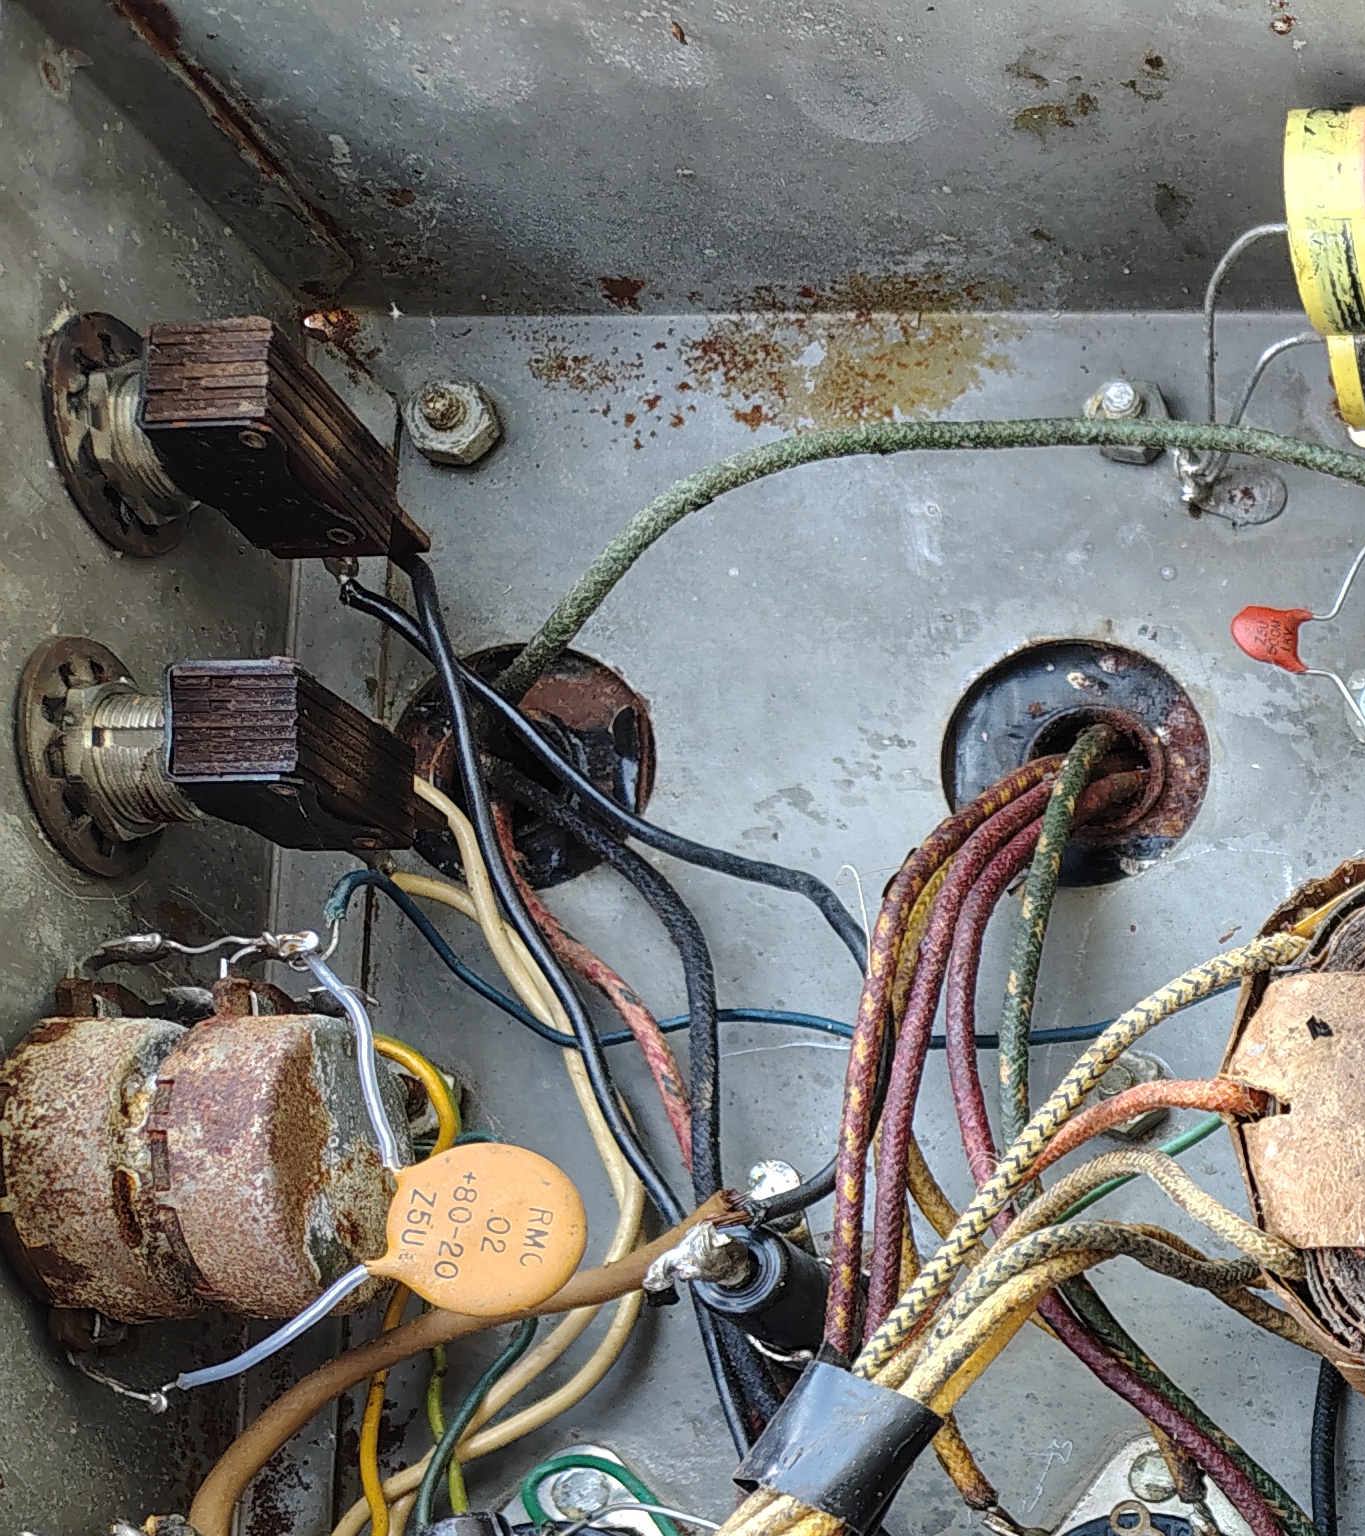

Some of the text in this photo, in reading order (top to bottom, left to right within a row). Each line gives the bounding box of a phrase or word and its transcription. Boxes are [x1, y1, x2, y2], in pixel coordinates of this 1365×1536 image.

[401, 1188, 437, 1247] Z5U
[434, 1171, 478, 1280] +80-20
[481, 1208, 511, 1255] .02
[518, 1207, 554, 1268] RMC
